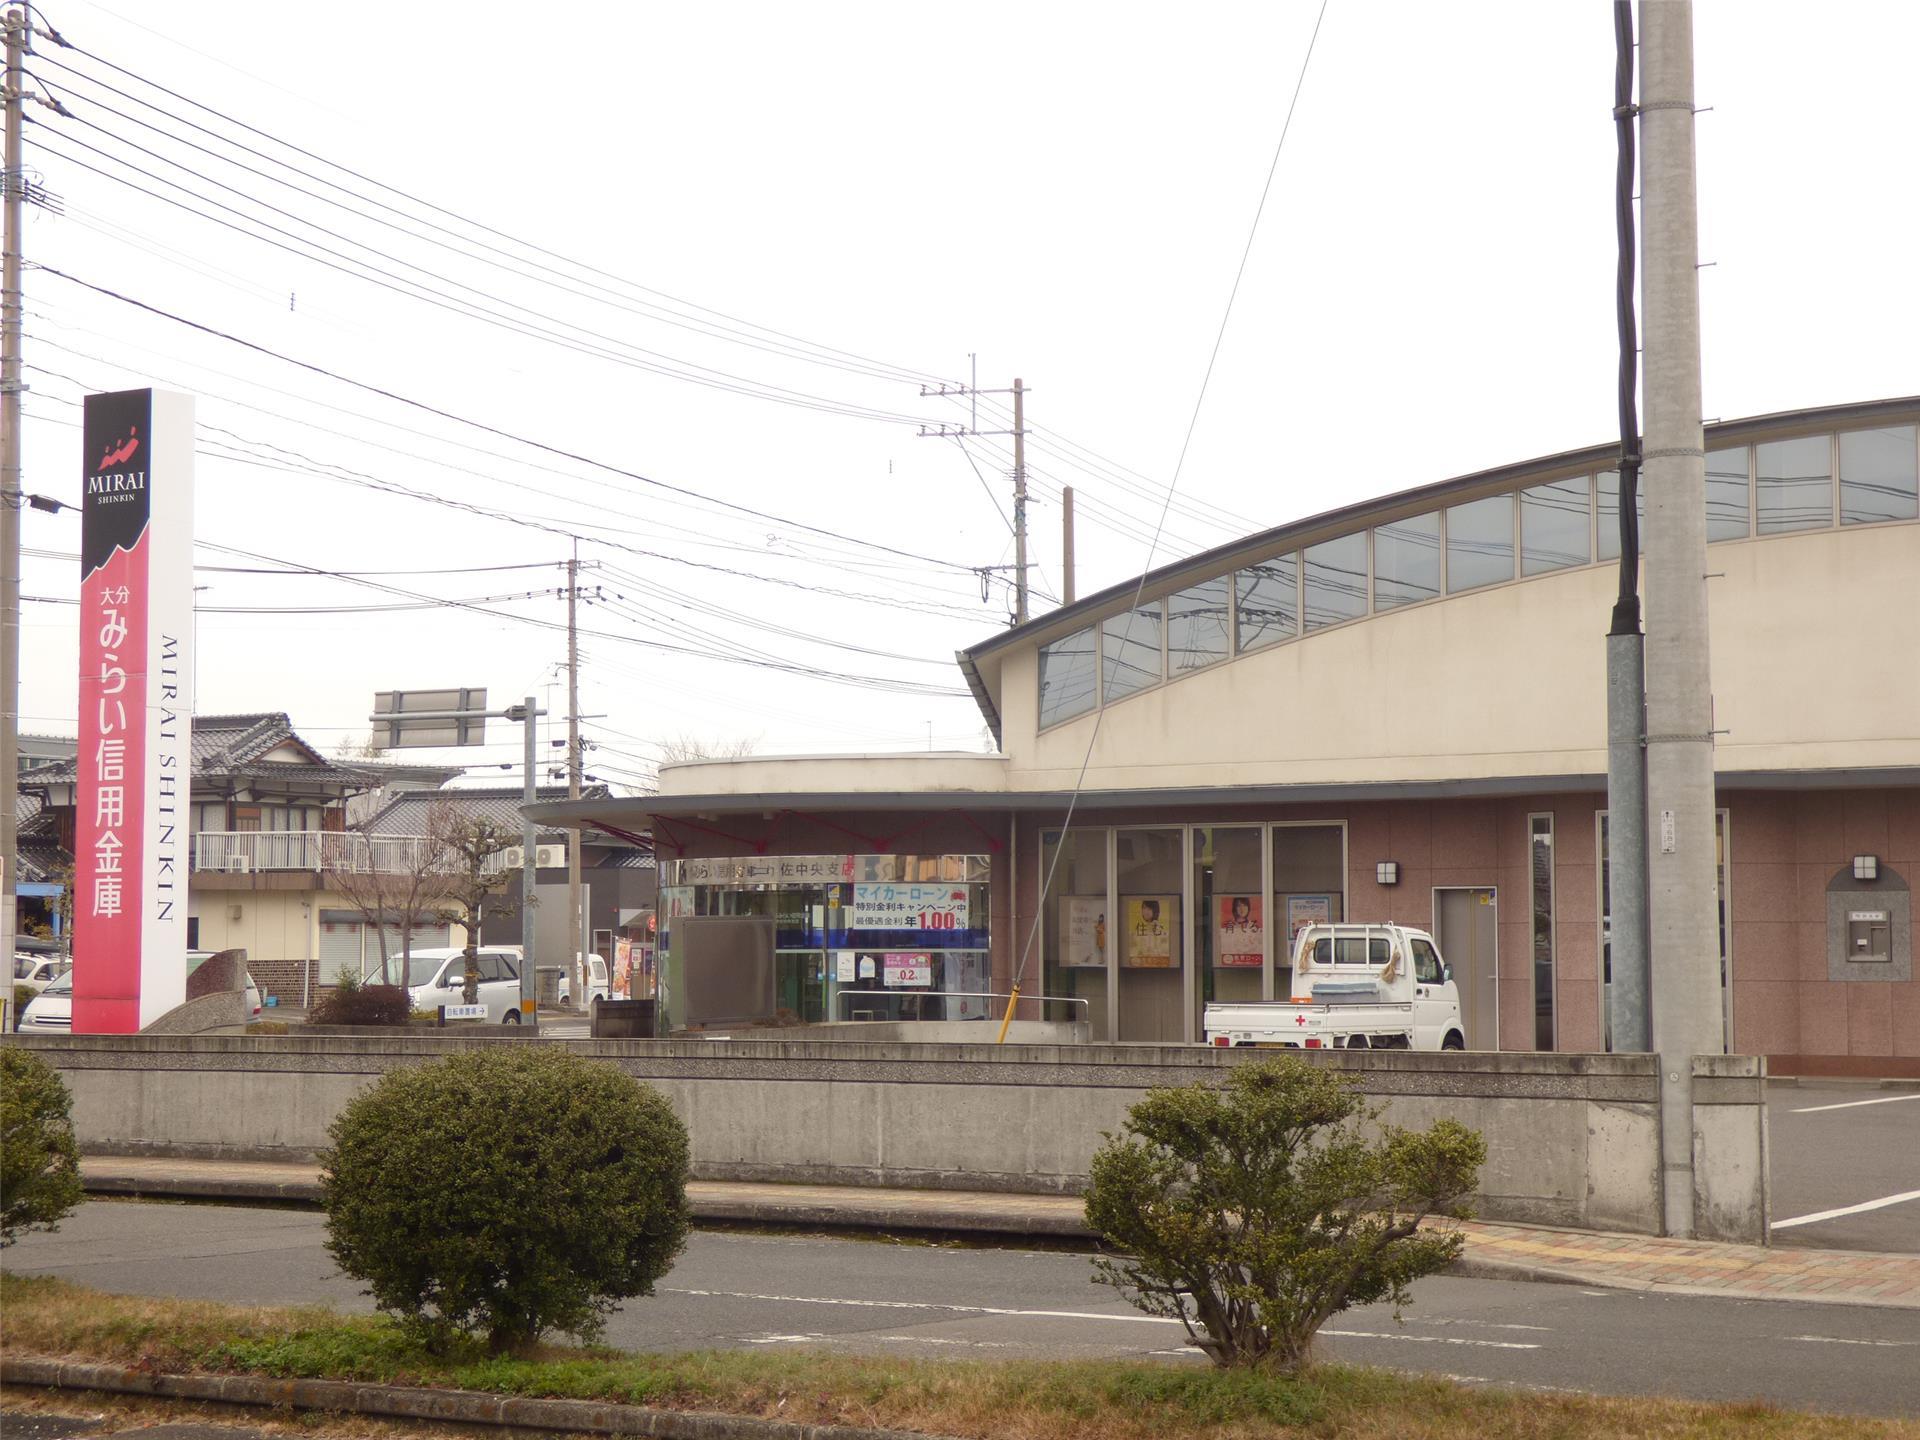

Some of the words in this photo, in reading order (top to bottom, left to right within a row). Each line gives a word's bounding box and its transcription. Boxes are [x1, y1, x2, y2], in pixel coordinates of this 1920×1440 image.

[88, 471, 145, 494] MIRAI
[97, 493, 136, 505] SHINKIN
[100, 585, 130, 606] 大分
[160, 635, 178, 740] MIRAI
[93, 608, 128, 919] みらい信用金庫
[157, 754, 177, 922] SHINKIN
[856, 886, 948, 901] マイカーローン
[856, 902, 966, 913] 特別金利キャンペーン中
